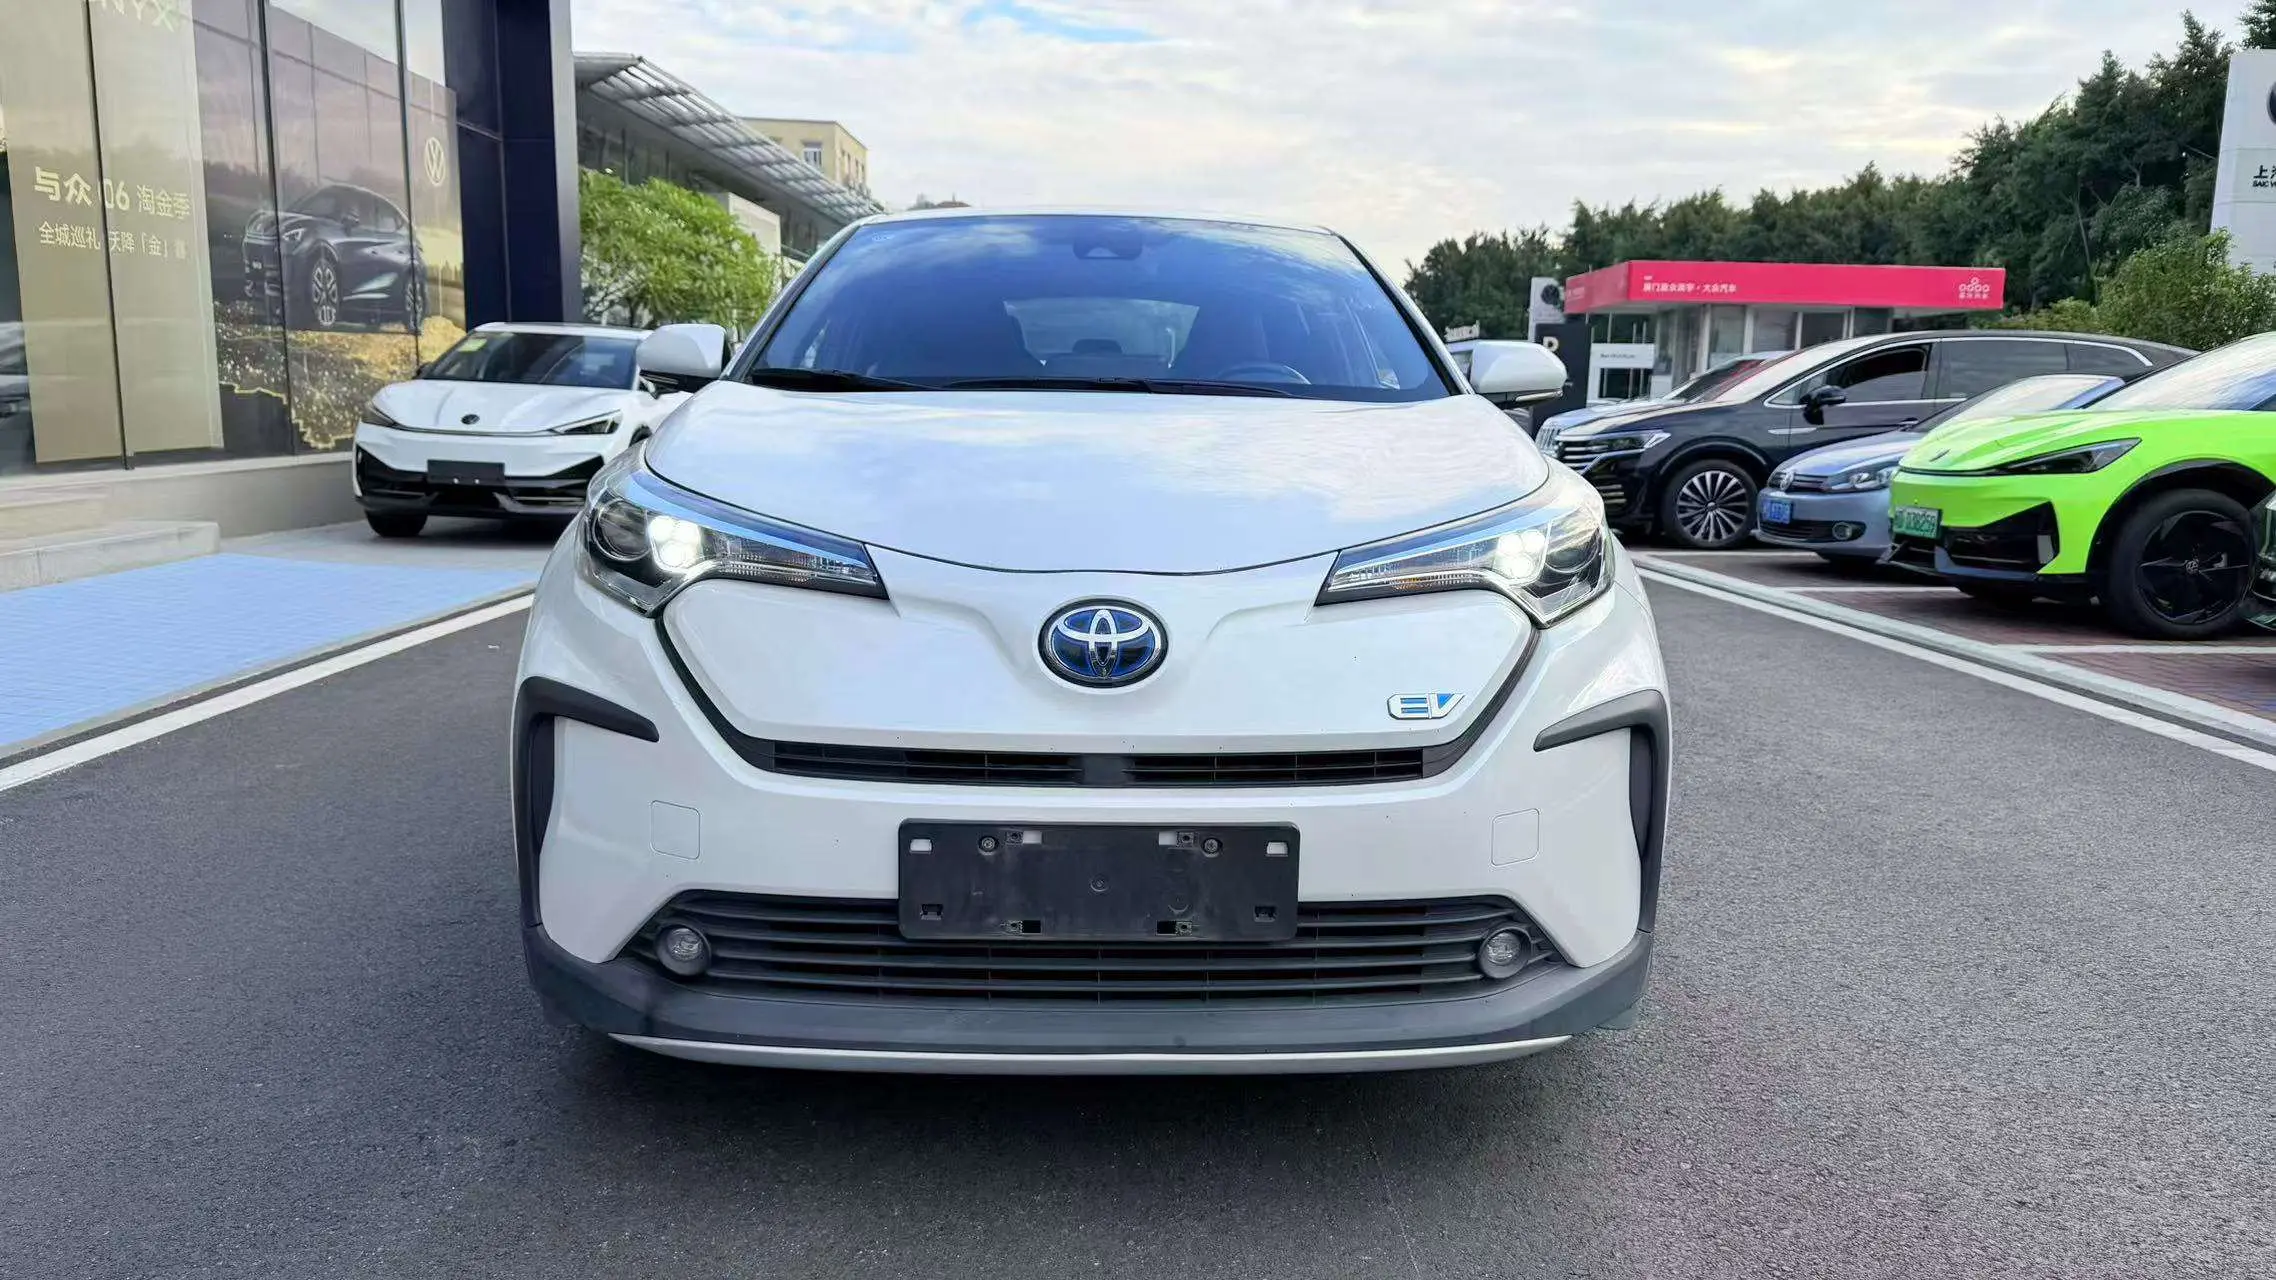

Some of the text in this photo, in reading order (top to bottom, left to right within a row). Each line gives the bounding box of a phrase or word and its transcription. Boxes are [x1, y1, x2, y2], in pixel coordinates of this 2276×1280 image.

[34, 166, 93, 207] 与众
[98, 178, 131, 211] 06
[38, 221, 101, 250] 全城巡礼
[1386, 692, 1467, 720] EV
